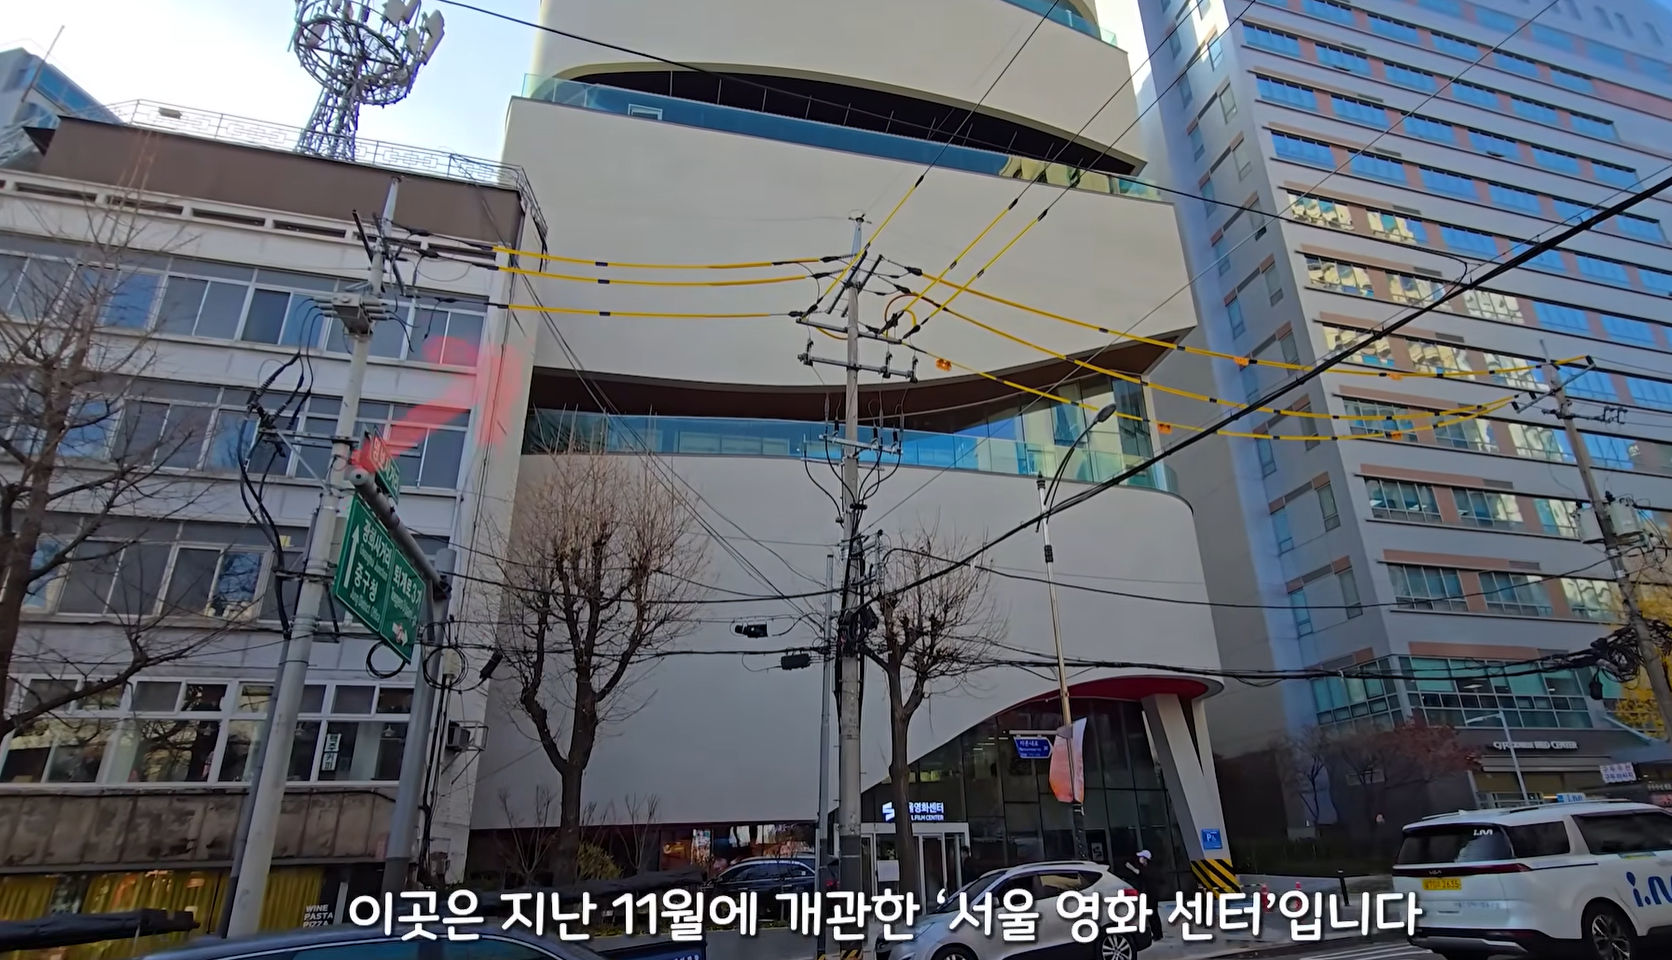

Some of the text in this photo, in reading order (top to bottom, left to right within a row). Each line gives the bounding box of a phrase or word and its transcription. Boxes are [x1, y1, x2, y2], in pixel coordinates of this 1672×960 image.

[354, 561, 379, 602] 중구청
[306, 904, 329, 912] WINE
[303, 912, 334, 921] PASTA
[302, 920, 329, 929] PIZZA
